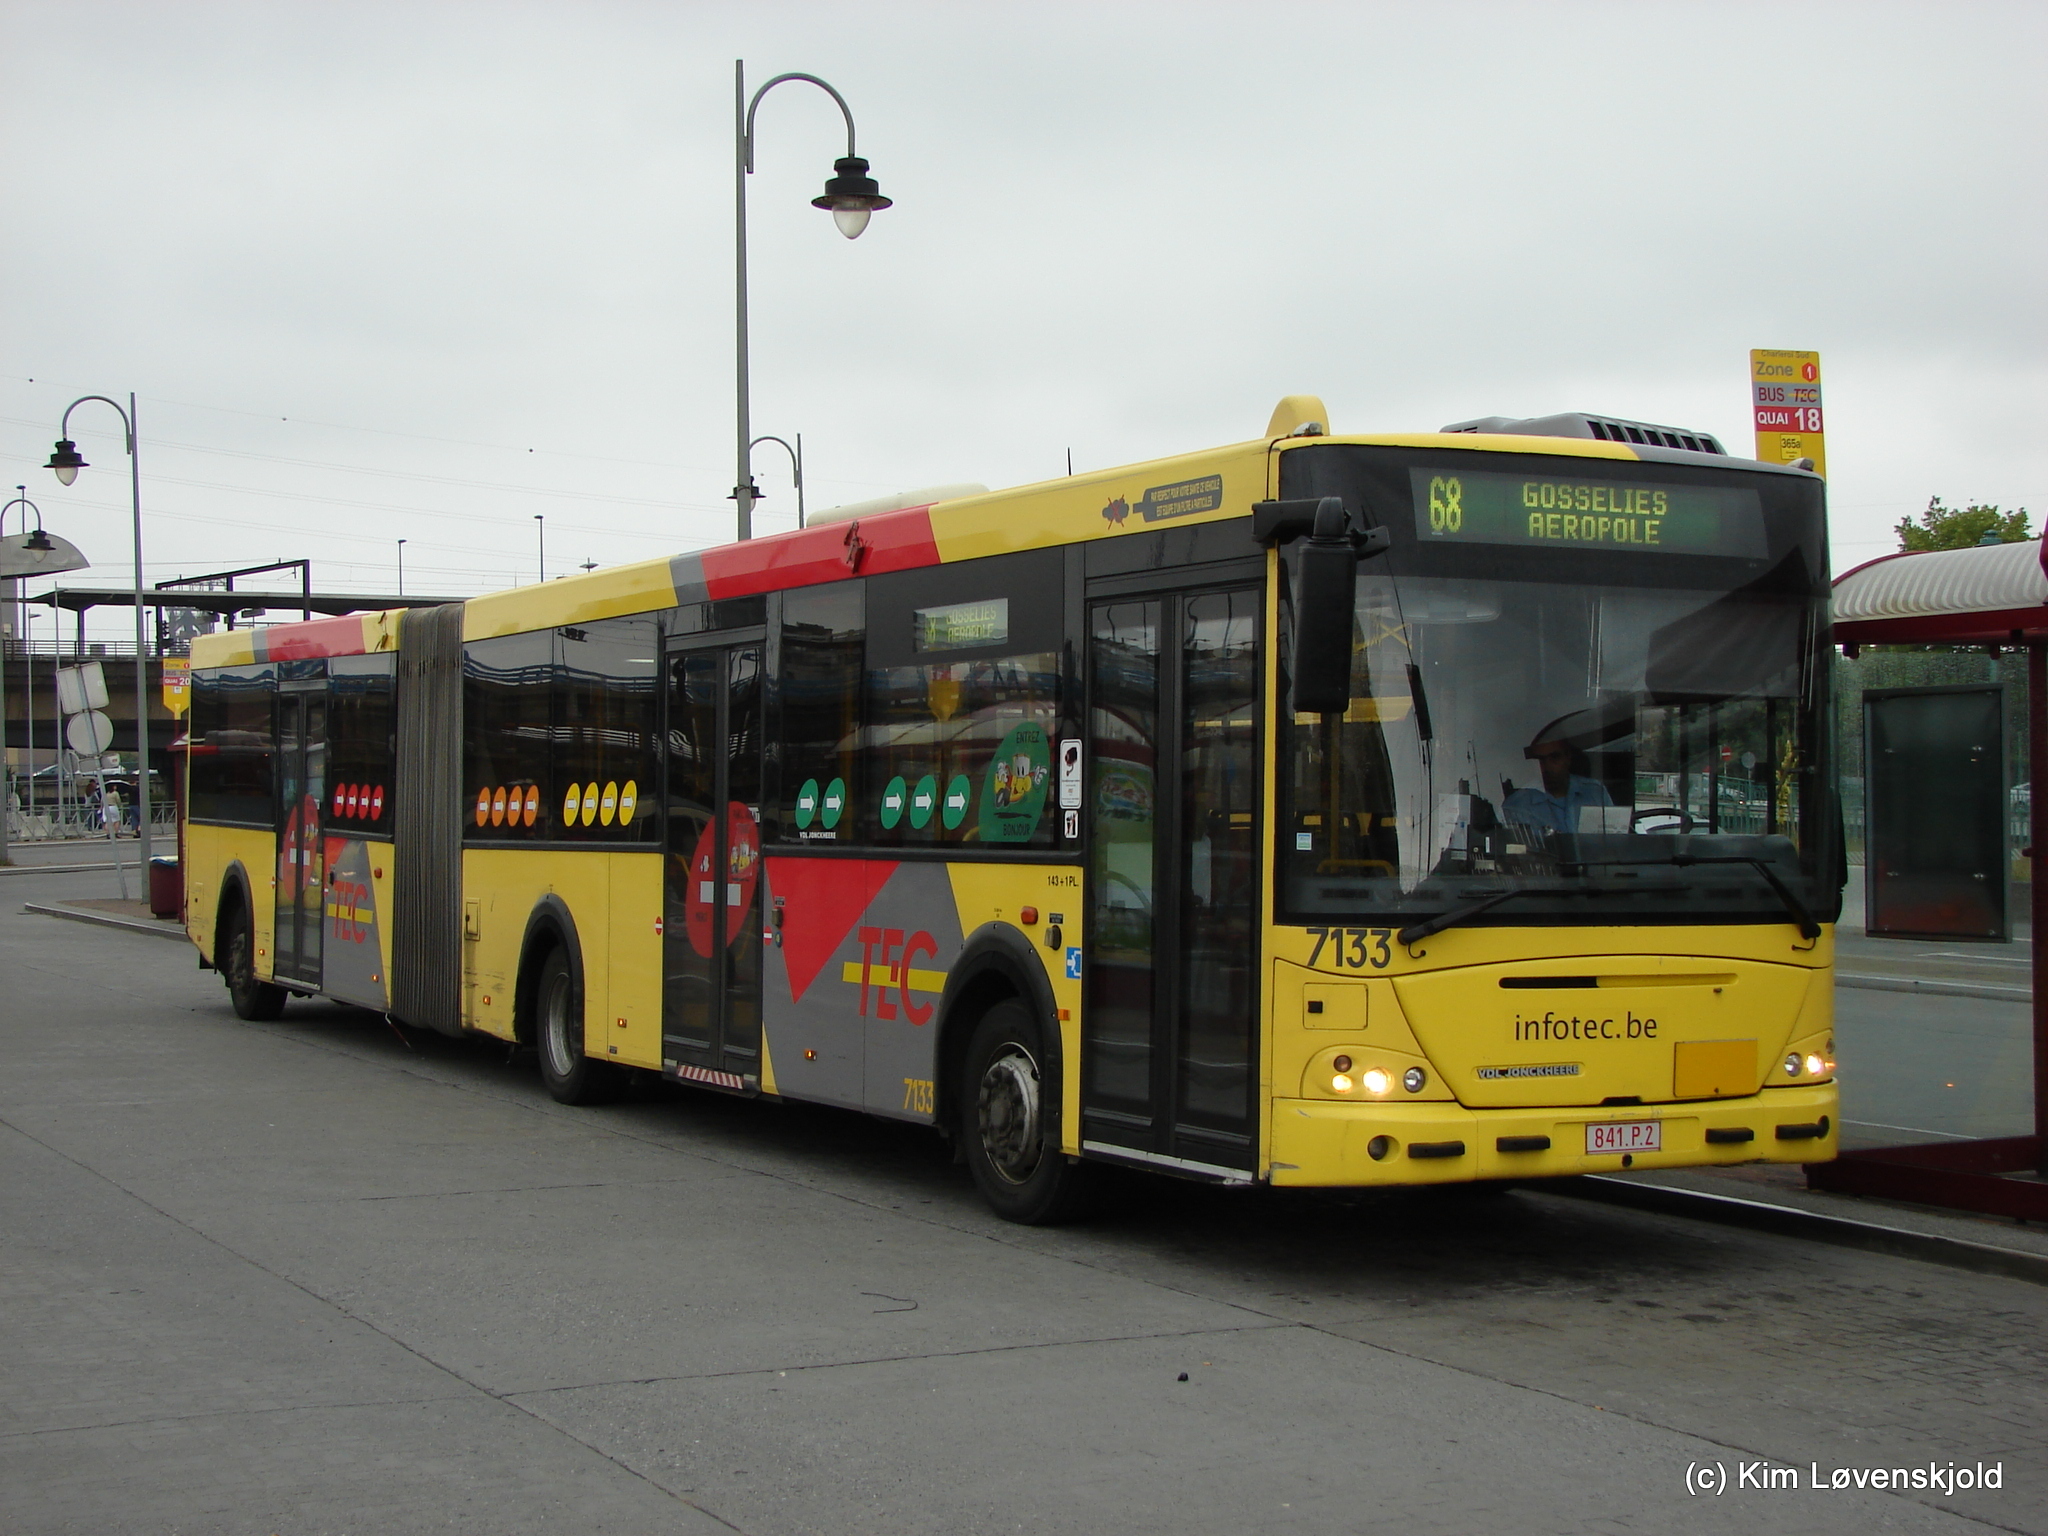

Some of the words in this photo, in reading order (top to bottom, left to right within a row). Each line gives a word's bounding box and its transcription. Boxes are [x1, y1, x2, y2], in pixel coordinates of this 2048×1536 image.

[1795, 351, 1810, 359] Sud
[1755, 361, 1793, 376] Zone
[1806, 366, 1812, 379] 1
[1758, 387, 1785, 402] BUS
[1794, 388, 1817, 403] TEC
[1757, 412, 1789, 425] QUAI
[1794, 408, 1821, 431] 18
[1781, 438, 1801, 449] 365a
[1429, 475, 1462, 533] 68
[1522, 481, 1668, 516] GOSSELIES
[1528, 512, 1661, 545] AEROPOLE
[946, 605, 997, 625] GOSSELIES
[179, 677, 190, 686] 20
[1016, 731, 1040, 744] ENTREZ
[1003, 823, 1031, 836] BONJOUR
[333, 880, 368, 944] TEC
[1306, 927, 1392, 969] 7133
[857, 925, 939, 1026] TEC
[1514, 1011, 1658, 1042] infotec.be
[1477, 1068, 1501, 1079] VDL
[1504, 1064, 1580, 1078] JONCKHEERE
[903, 1077, 934, 1114] 7133
[1595, 1125, 1654, 1148] 841.P.2
